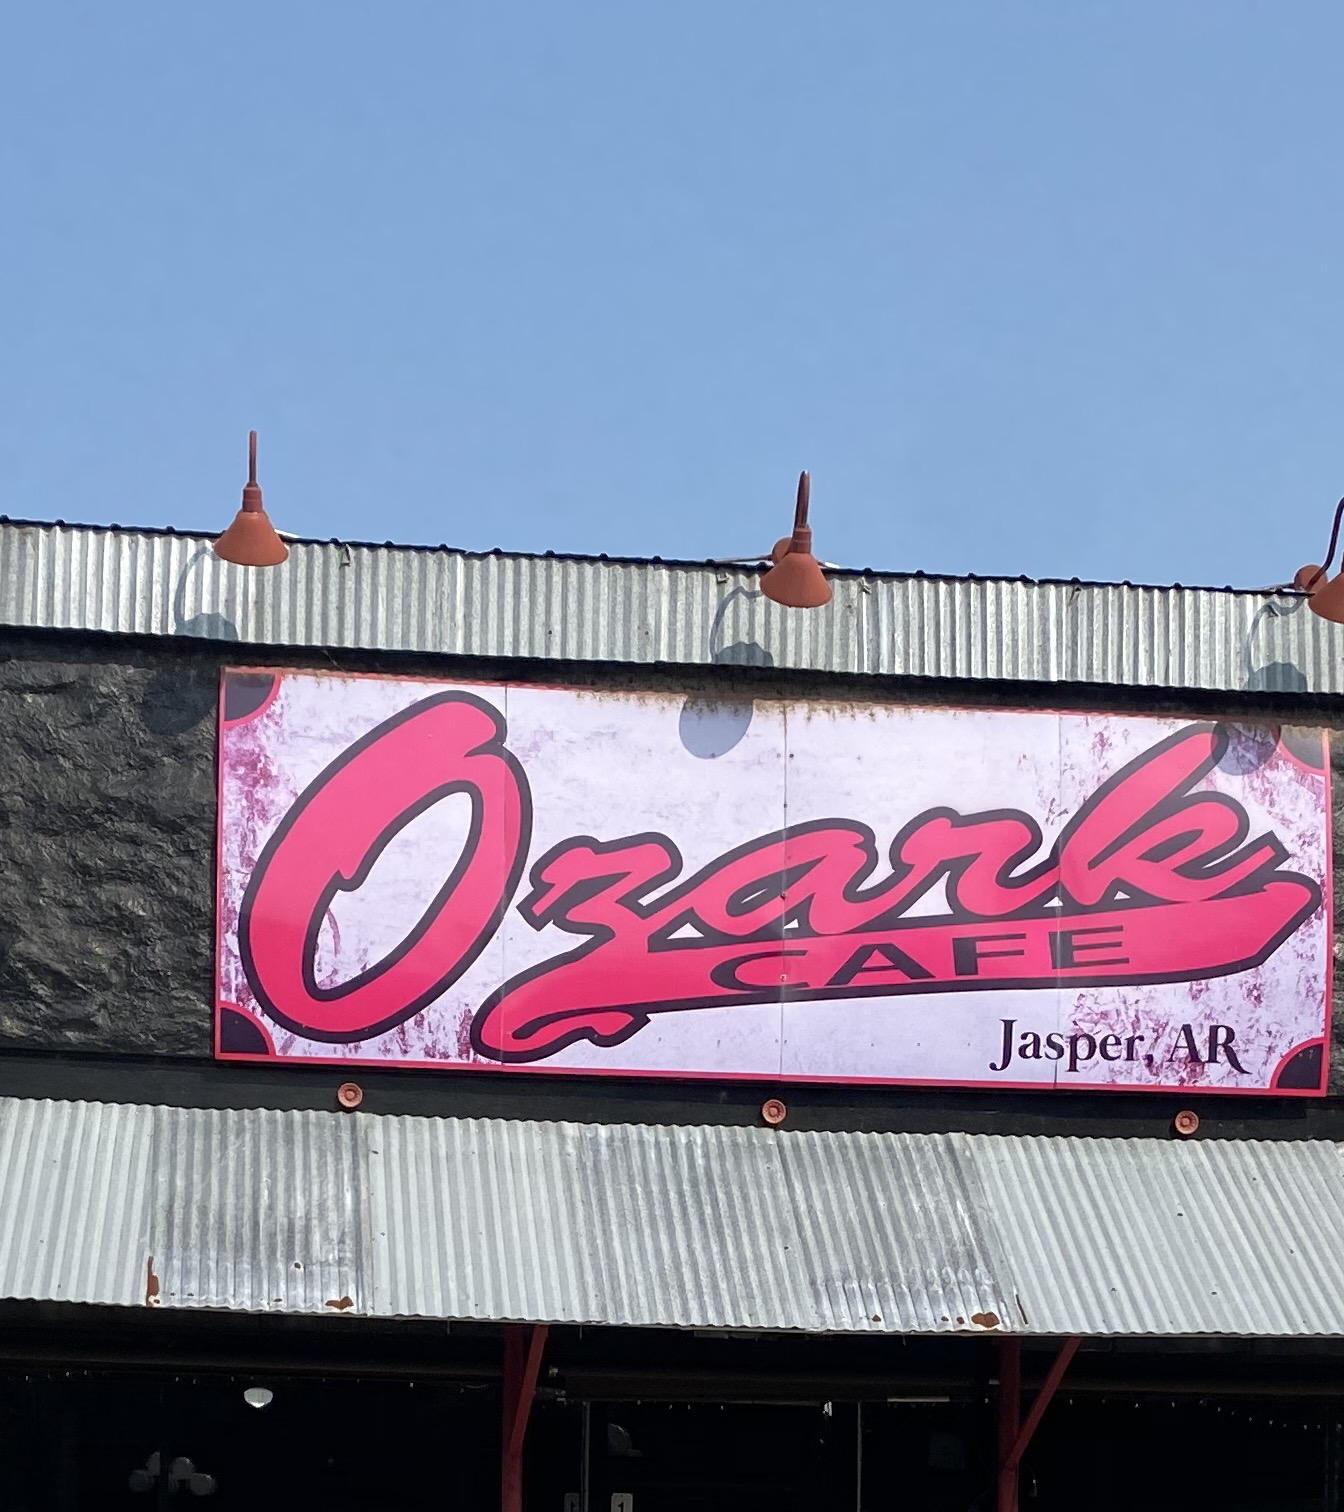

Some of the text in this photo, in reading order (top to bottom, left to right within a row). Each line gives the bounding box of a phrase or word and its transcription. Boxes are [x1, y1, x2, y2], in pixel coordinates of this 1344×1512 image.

[238, 690, 1323, 1064] Ozark
[710, 924, 1130, 992] CAFE
[989, 1018, 1254, 1075] Jasper, AR
